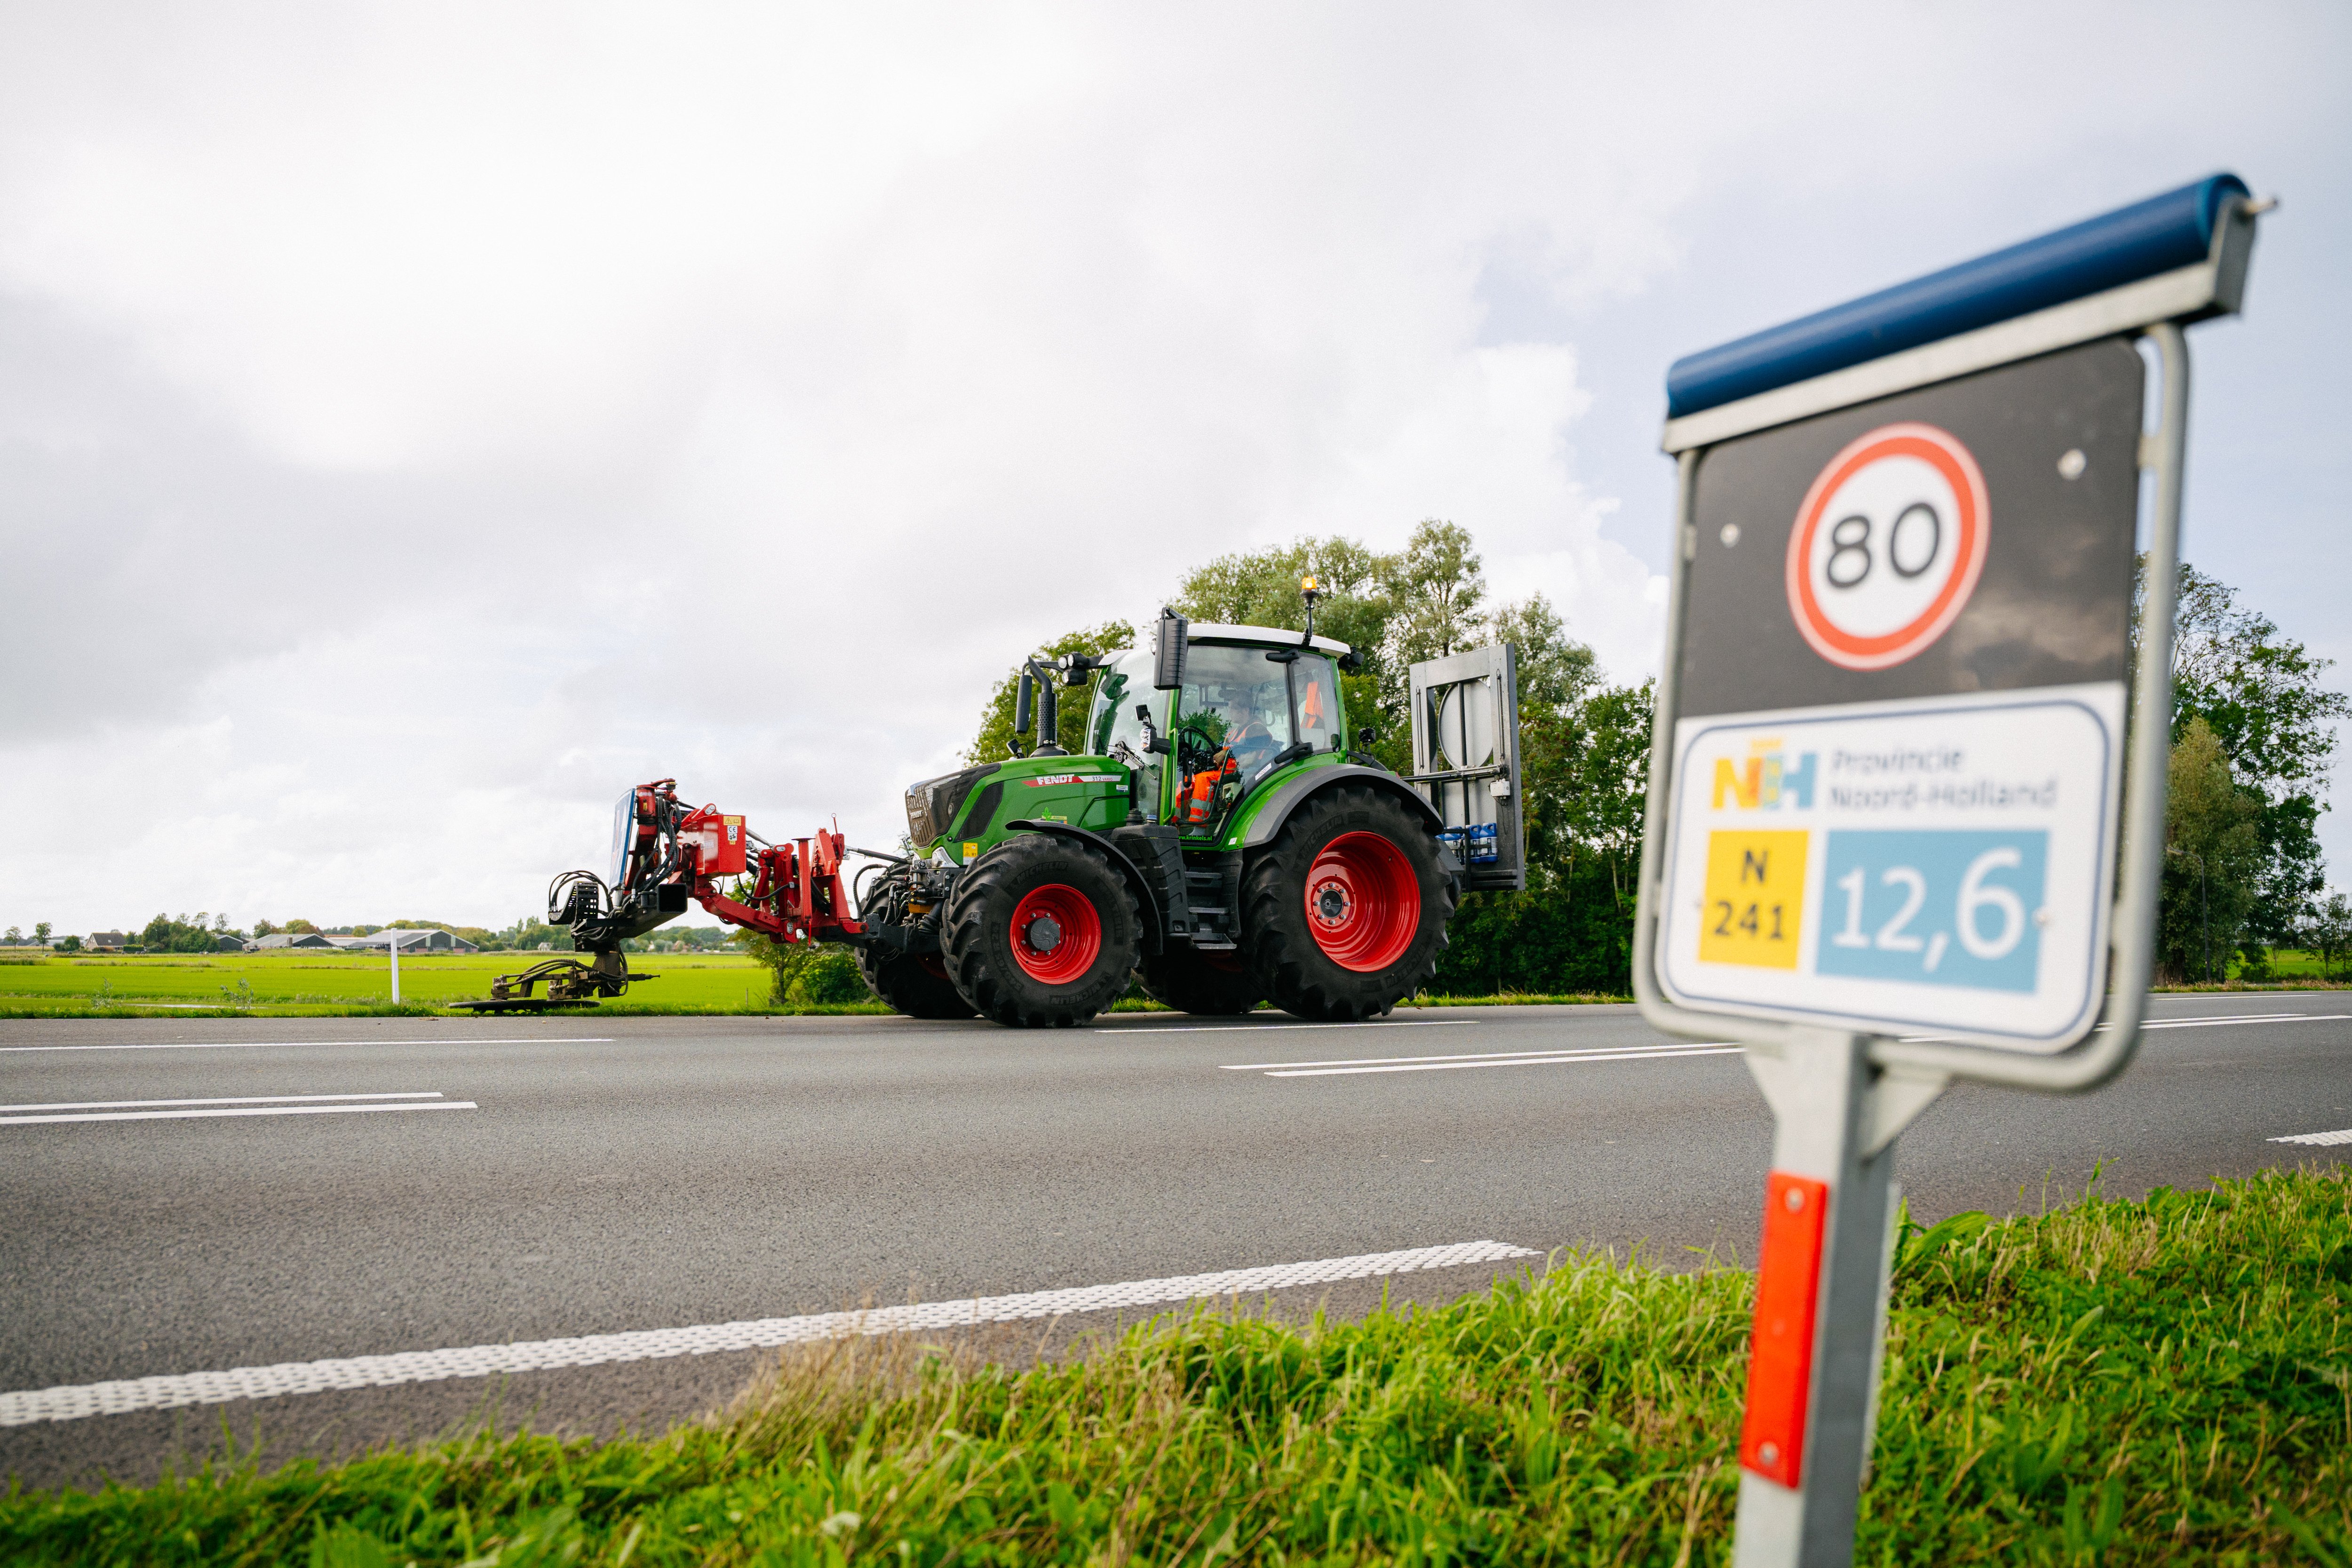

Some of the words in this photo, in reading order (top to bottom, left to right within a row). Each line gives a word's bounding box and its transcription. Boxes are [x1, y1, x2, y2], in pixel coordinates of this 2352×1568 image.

[1827, 501, 1939, 589] 80
[1832, 747, 1963, 772] Provincie
[1036, 774, 1074, 785] FENDT
[1831, 776, 2058, 809] Noord-Holland
[1016, 861, 1068, 884] MICHELIN
[1742, 850, 1768, 883] N
[1713, 900, 1785, 940] 241
[1832, 847, 2026, 972] 12,6
